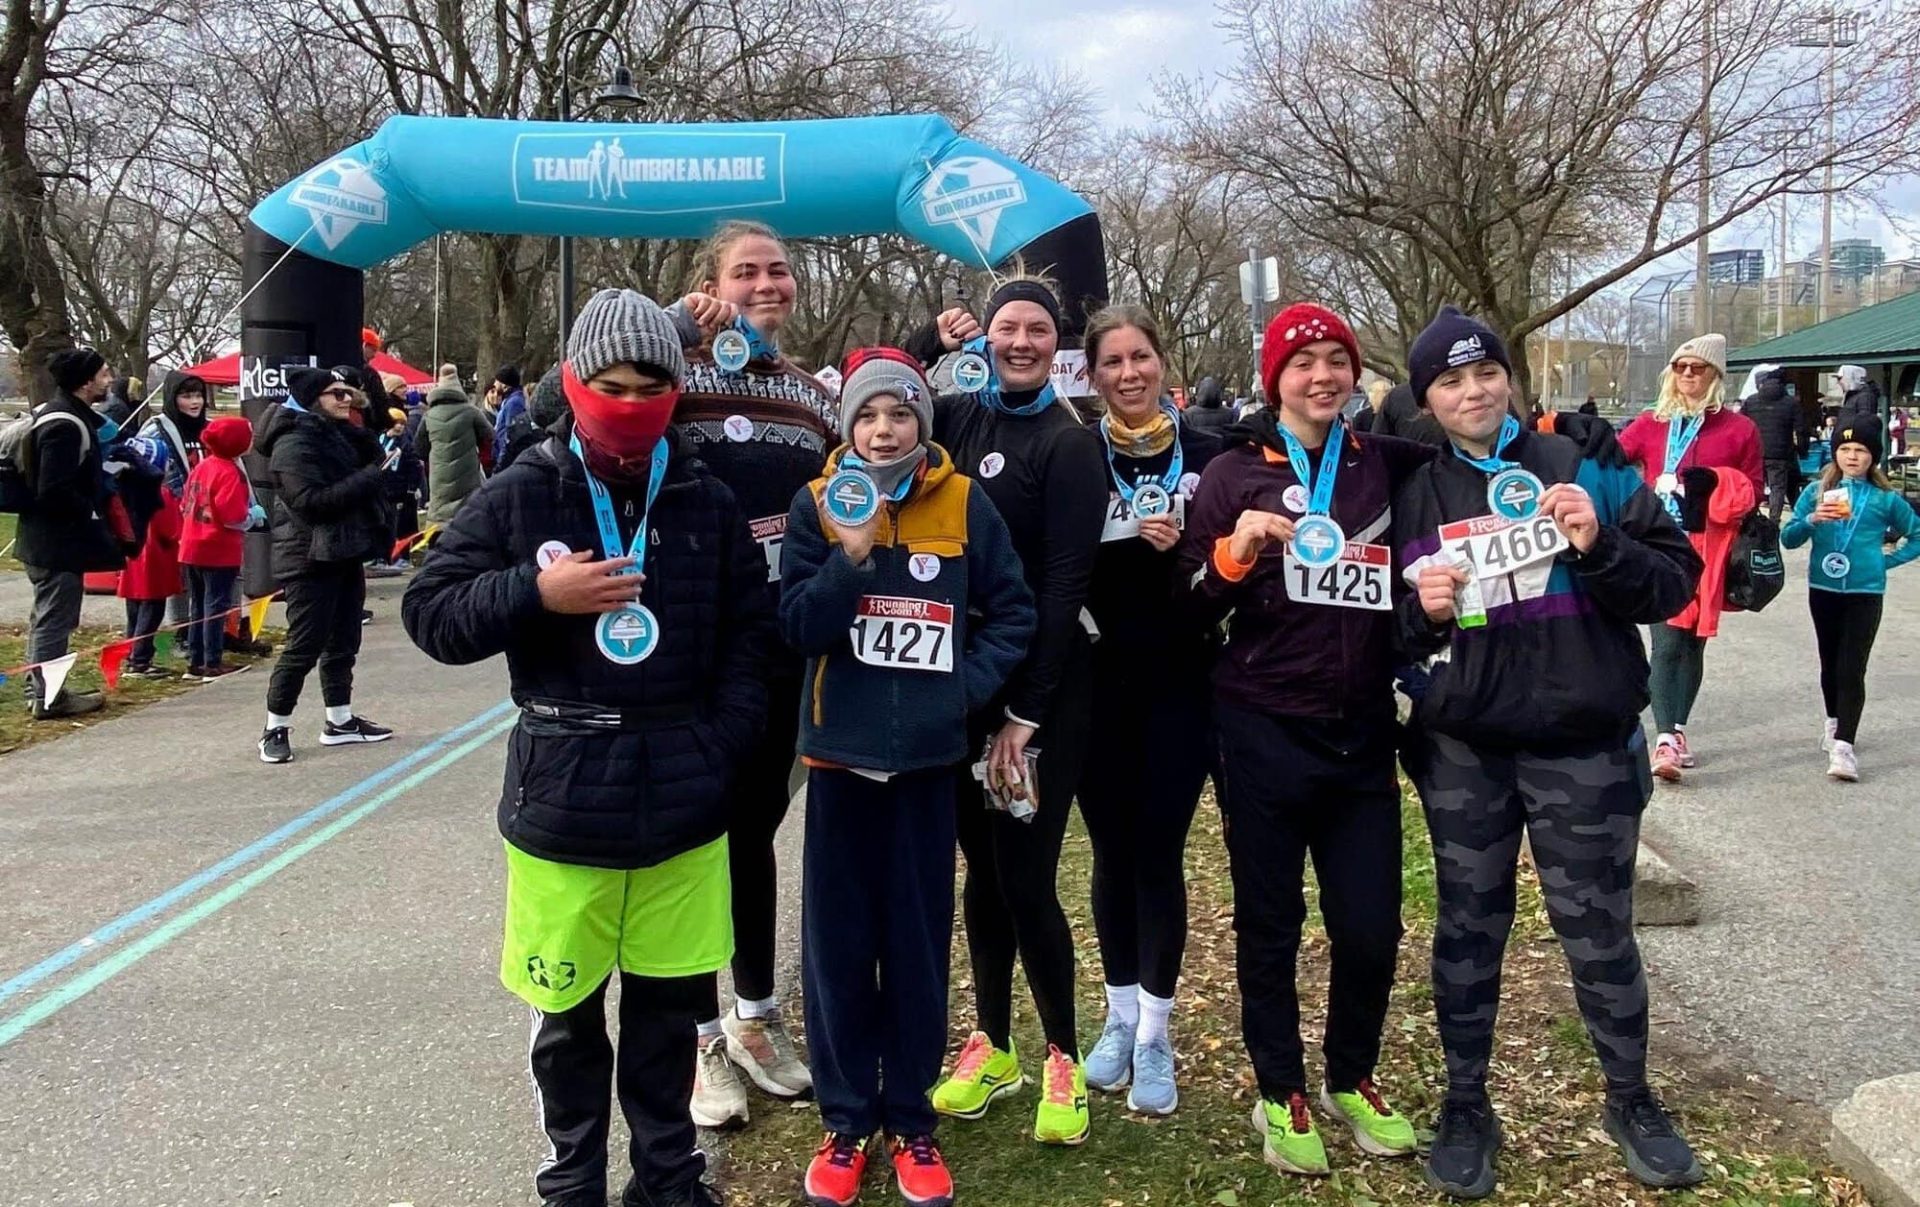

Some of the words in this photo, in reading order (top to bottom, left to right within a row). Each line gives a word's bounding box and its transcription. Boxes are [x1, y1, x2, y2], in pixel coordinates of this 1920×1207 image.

[532, 156, 590, 182] TEAM
[619, 156, 766, 182] UNBREAKABLE
[263, 387, 290, 397] RUNN
[750, 517, 782, 533] unning
[1455, 518, 1558, 575] 1466
[1293, 562, 1383, 606] 1425
[876, 599, 922, 614] Running
[850, 617, 946, 666] 1427
